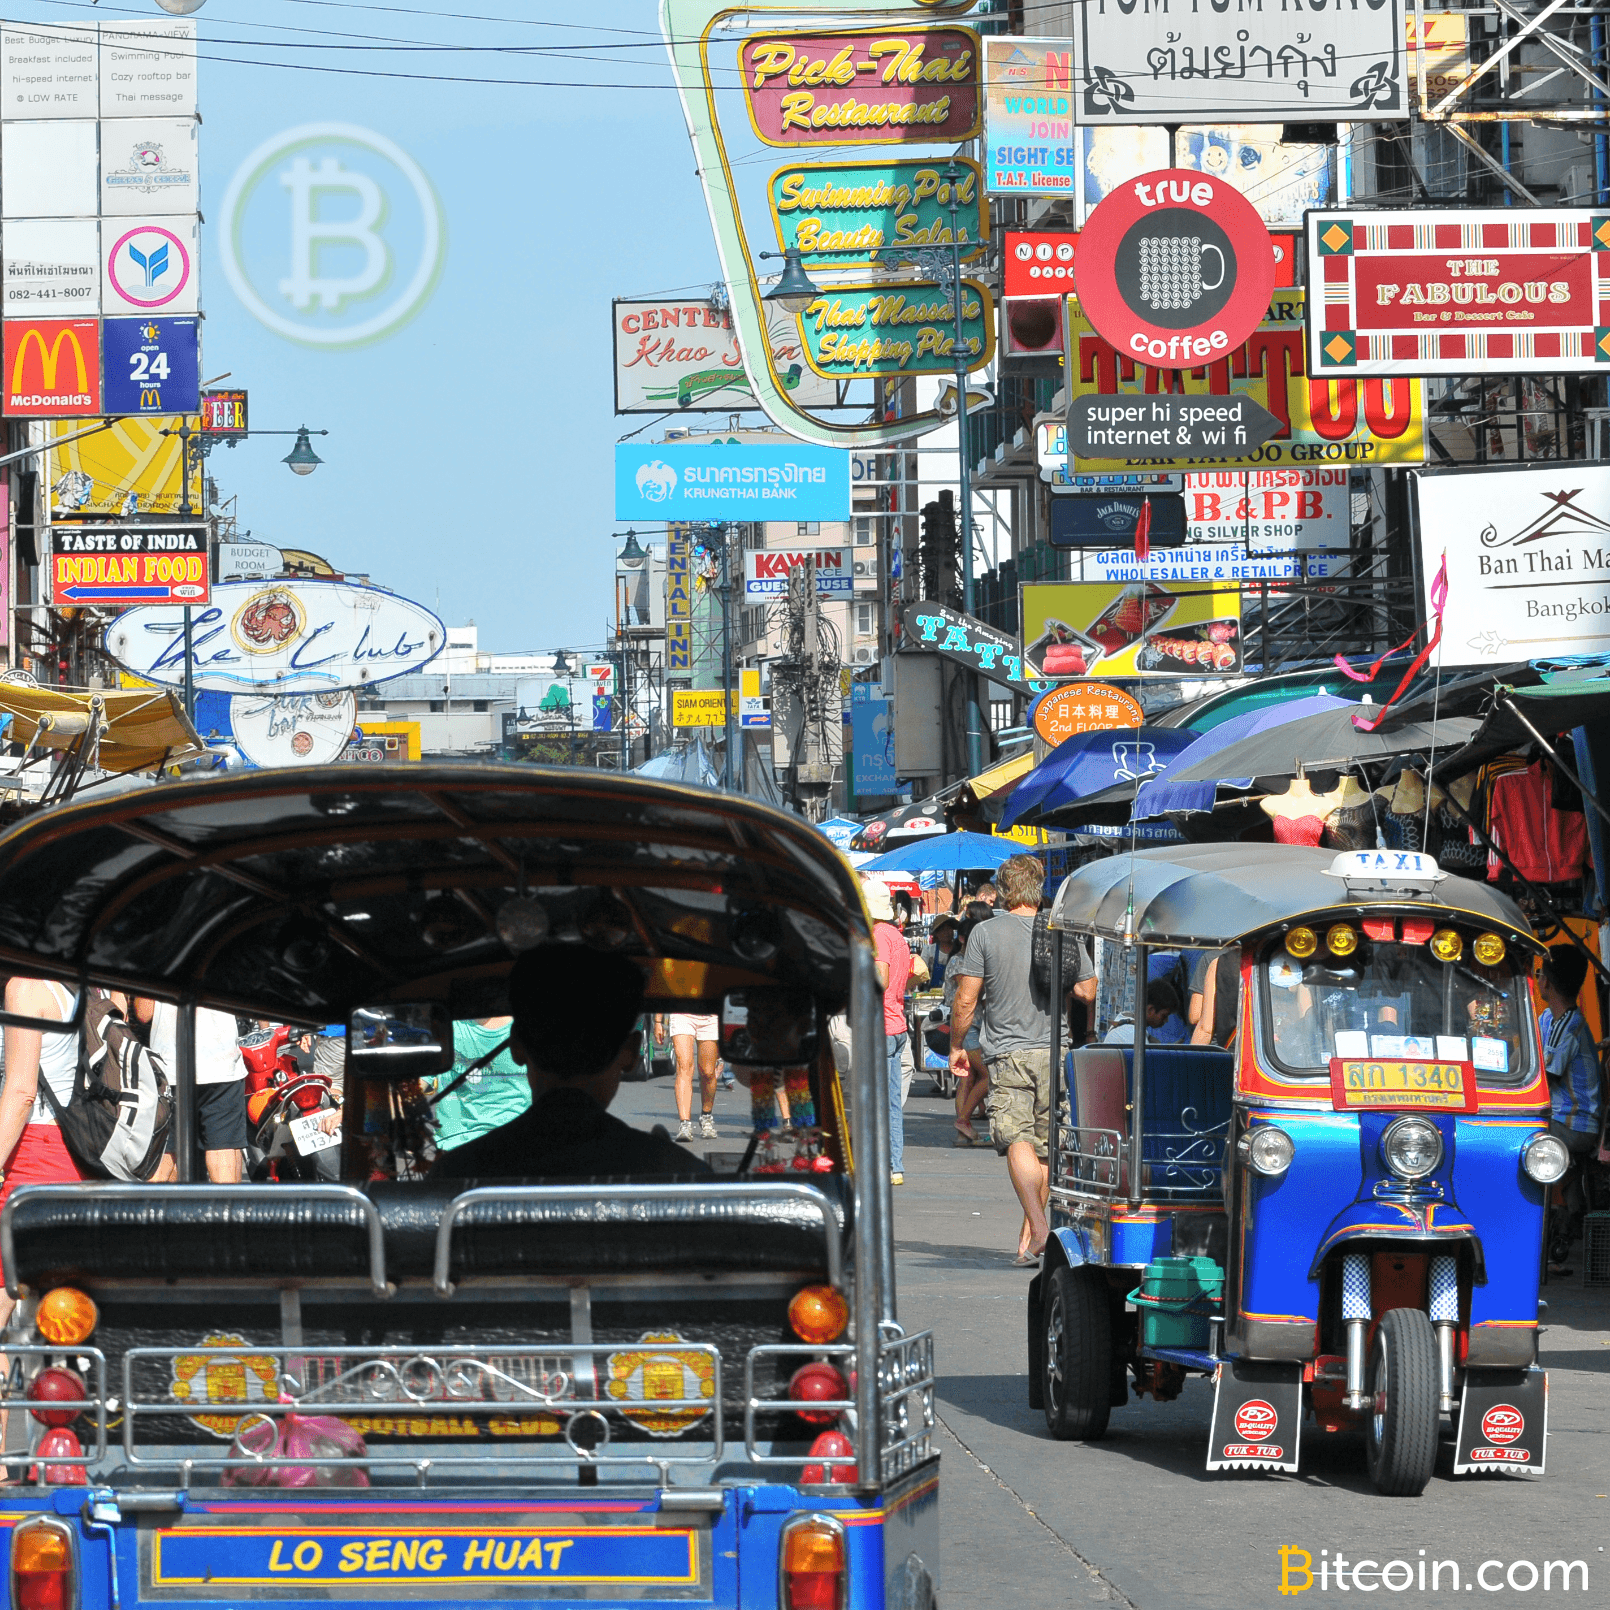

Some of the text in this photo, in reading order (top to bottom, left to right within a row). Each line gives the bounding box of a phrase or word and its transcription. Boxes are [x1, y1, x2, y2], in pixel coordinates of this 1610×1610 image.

[4, 35, 94, 46] Best Budget Luxury
[8, 54, 93, 64] Breakfast included
[110, 52, 160, 61] Swimming
[751, 39, 972, 89] Pick-Thai
[1146, 29, 1336, 98] ต้มยำกุ้ง
[12, 74, 93, 84] hi-speed internet
[110, 72, 191, 82] Cozy rooftop bar
[16, 94, 78, 103] @ LOW RATE
[116, 93, 184, 102] Thai message
[1005, 97, 1069, 115] WORLD
[781, 92, 951, 130] Restaurant
[1029, 121, 1069, 139] JOIN
[996, 146, 1048, 166] SIGHT
[996, 171, 1072, 187] T.A.T. License
[779, 173, 911, 216] Swimming
[1134, 180, 1214, 207] true
[797, 217, 884, 259] Beauty
[1446, 259, 1500, 276] THE
[9, 287, 92, 300] 082-441-8007
[1376, 282, 1571, 305] FABULOUS
[806, 299, 866, 330] Thai
[1413, 311, 1534, 321] Bar & Dessert Cafe
[622, 335, 715, 367] Khao
[817, 333, 912, 368] Shopping
[1129, 330, 1230, 360] coffee
[129, 352, 171, 380] 24
[10, 394, 92, 406] McDonald's
[202, 401, 245, 428] BEER
[1087, 402, 1242, 426] super hi speed
[1087, 426, 1171, 445] internet
[1176, 426, 1192, 445] &
[1202, 426, 1226, 445] wi
[1234, 425, 1247, 445] fi
[1290, 442, 1375, 461] GROUP
[683, 462, 826, 490] ธนาคารกรุงไทย
[684, 487, 798, 499] KRUNGTHAI BANK
[1207, 525, 1260, 538] SILVER
[1264, 524, 1303, 537] SHOP
[62, 534, 198, 551] TASTE OF INDIA
[230, 548, 270, 558] BUDGET
[1478, 555, 1519, 575] Ban
[1523, 548, 1573, 573] Thai
[57, 556, 203, 583] INDIAN FOOD
[235, 561, 265, 570] ROOM
[755, 552, 842, 578] KAWIN
[1106, 567, 1209, 580] WHOLESALER
[1214, 566, 1225, 578] &
[290, 622, 425, 670] Club
[670, 624, 689, 669] INN
[974, 626, 1014, 651] Amazing
[677, 699, 698, 708] SIAM
[1038, 685, 1141, 723] Japanese Restaurant
[1059, 704, 1119, 720] 日本料理
[1050, 720, 1072, 732] 2nd
[1356, 853, 1423, 871] TAXI
[1400, 1064, 1459, 1089] 1340
[268, 1538, 575, 1572] LO SENG HUAT
